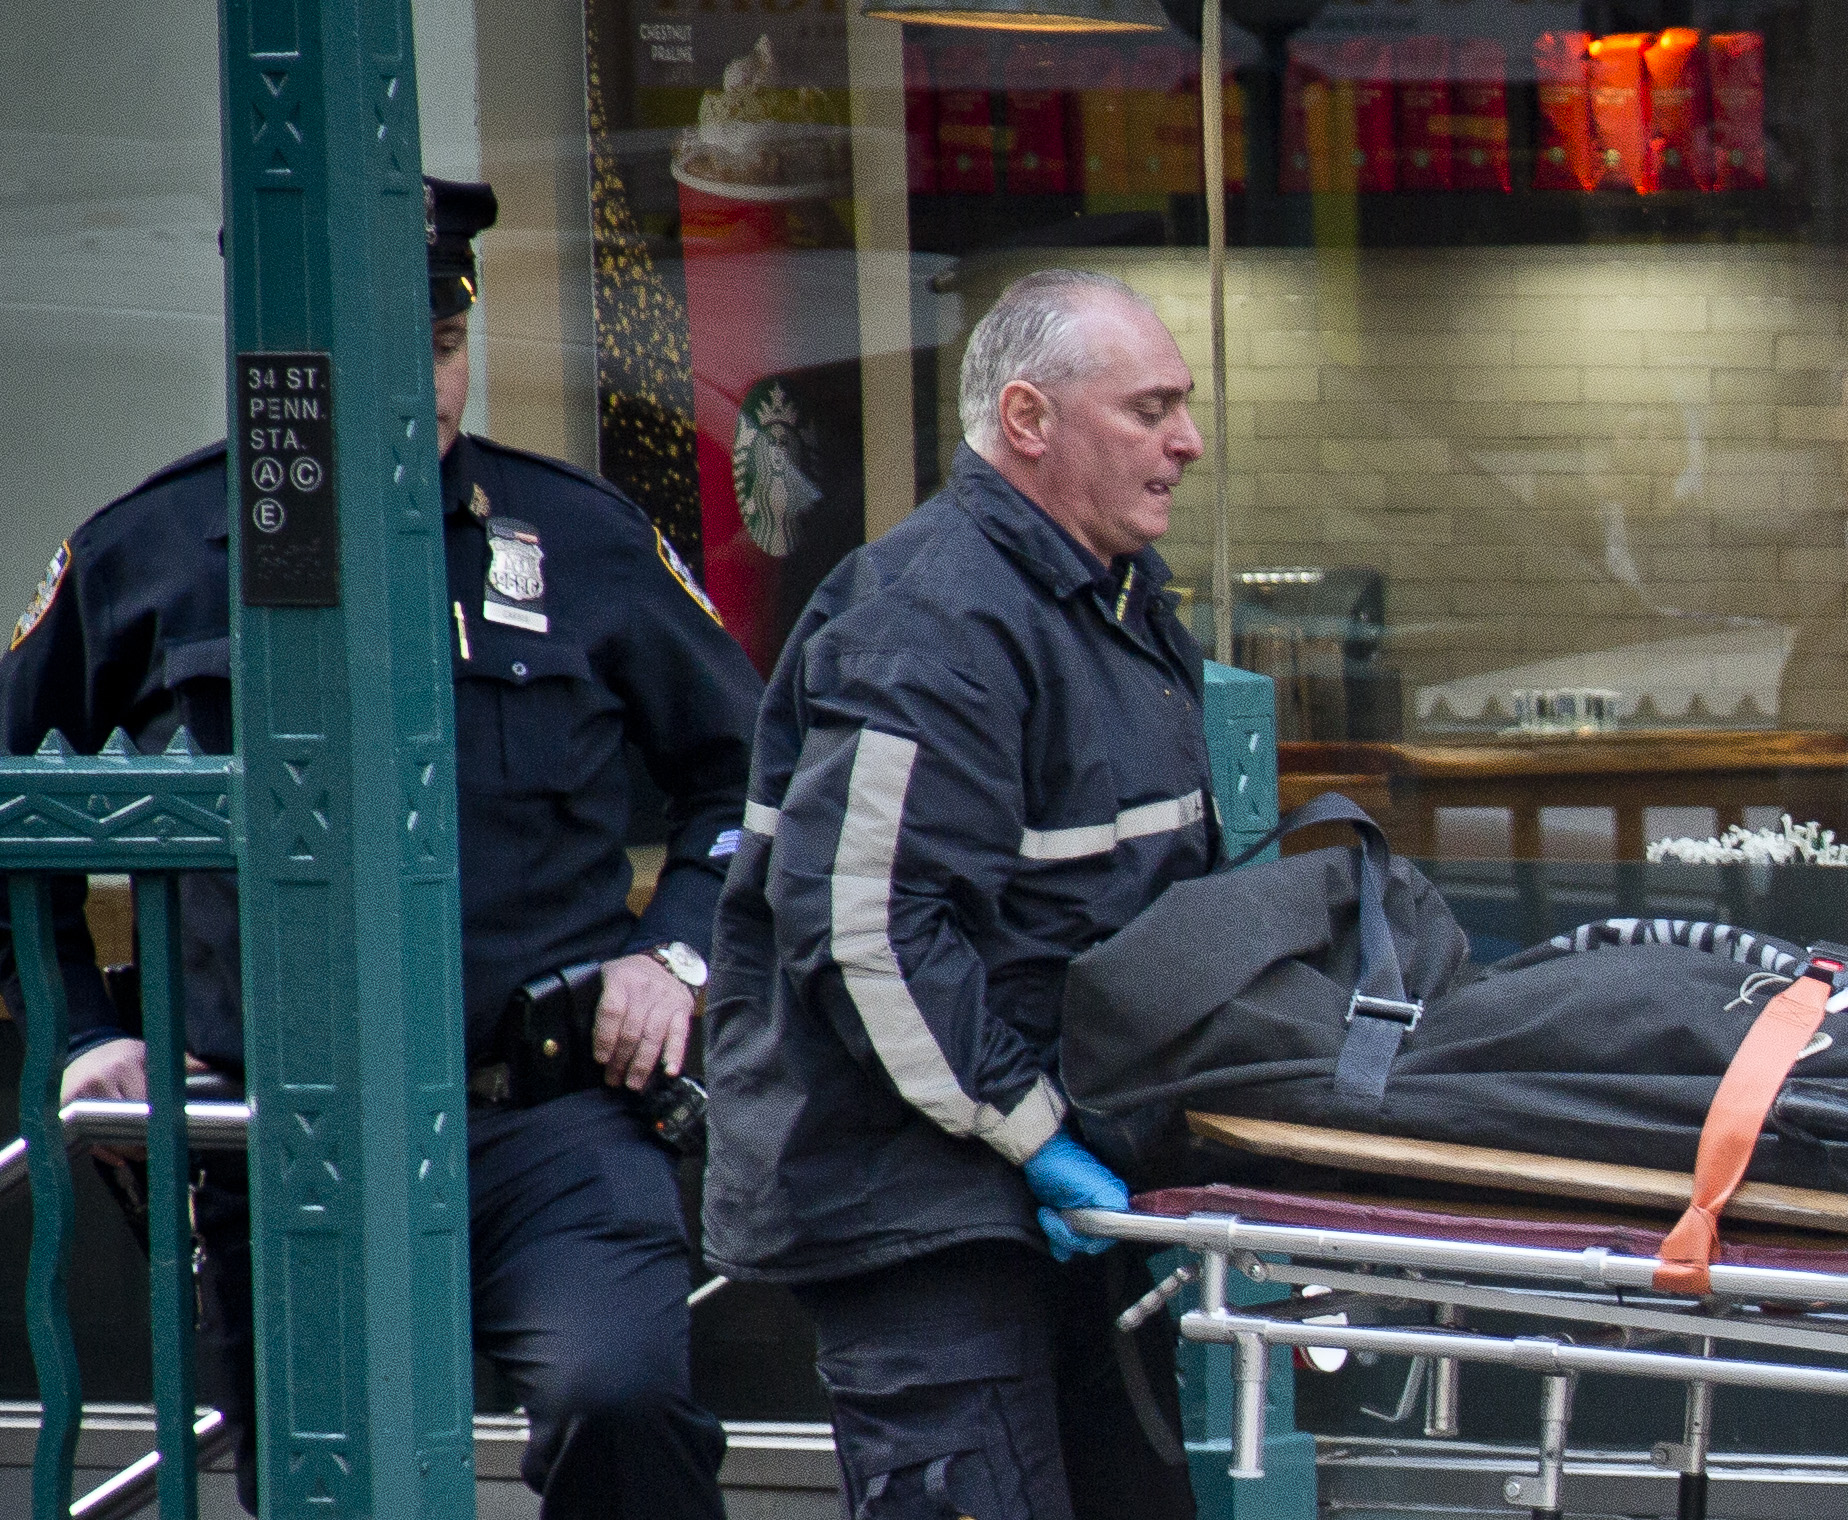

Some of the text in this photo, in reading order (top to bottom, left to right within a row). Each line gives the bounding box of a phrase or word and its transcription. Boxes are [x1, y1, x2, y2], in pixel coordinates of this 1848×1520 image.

[248, 367, 328, 390] 34 ST.
[250, 397, 328, 420] PENN.
[250, 427, 308, 450] STA.
